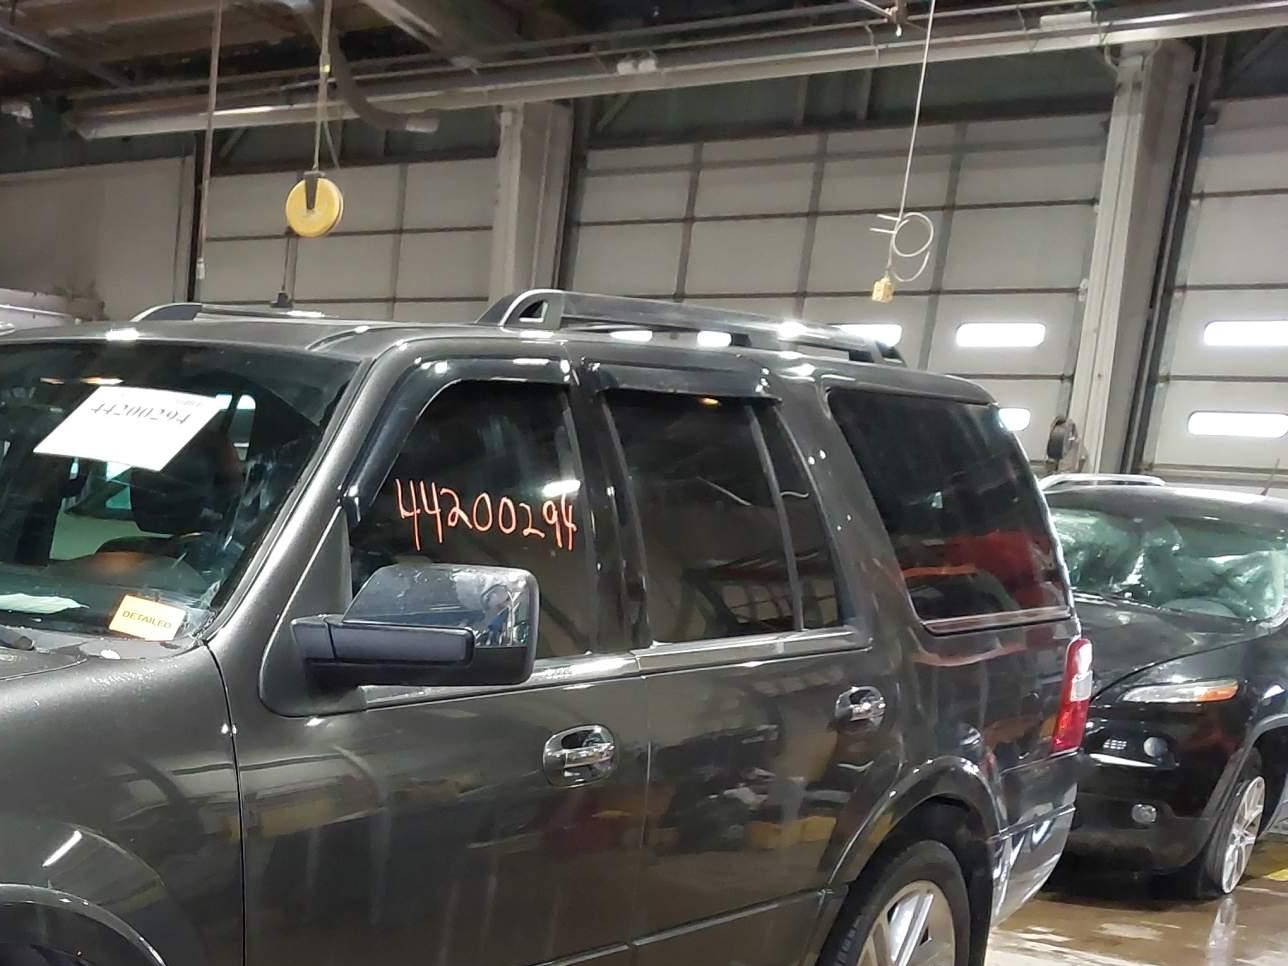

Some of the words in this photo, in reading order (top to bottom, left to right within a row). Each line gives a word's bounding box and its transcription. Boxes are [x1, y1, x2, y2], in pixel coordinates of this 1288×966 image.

[90, 401, 192, 425] 44200294
[394, 477, 578, 552] 44200294
[122, 609, 173, 629] DETAILED
